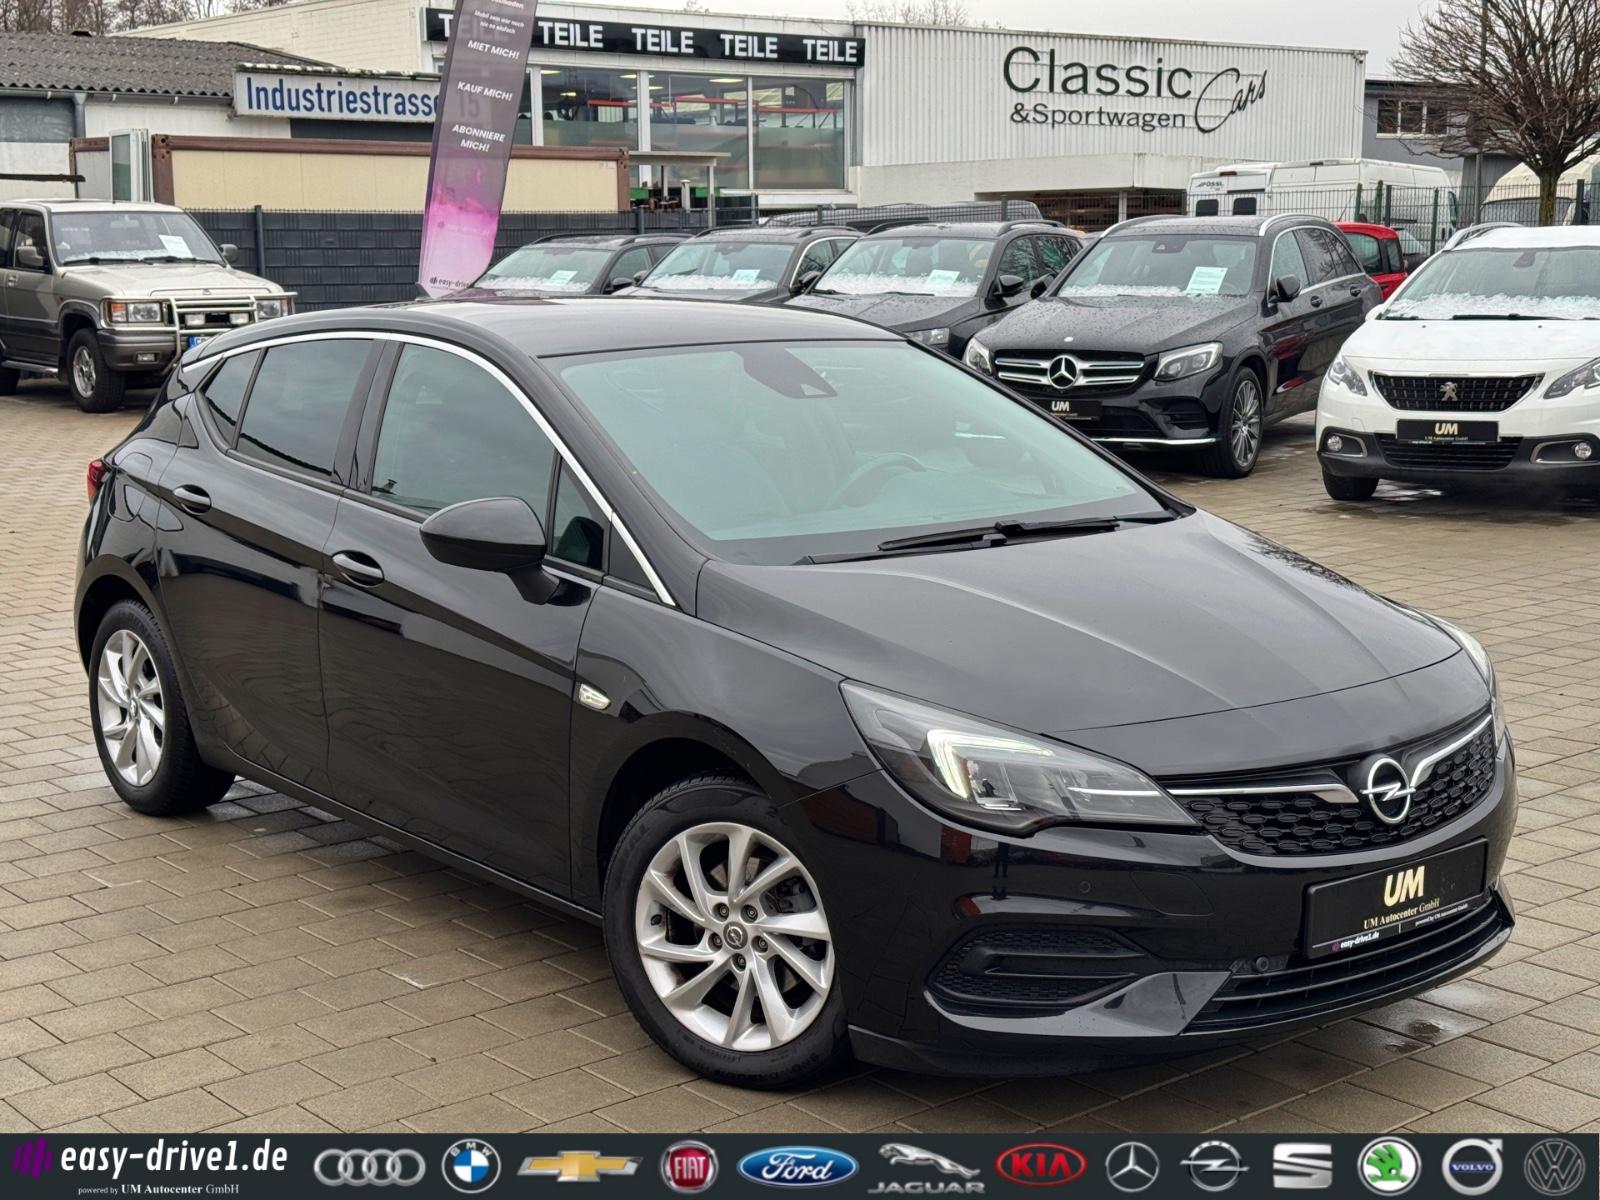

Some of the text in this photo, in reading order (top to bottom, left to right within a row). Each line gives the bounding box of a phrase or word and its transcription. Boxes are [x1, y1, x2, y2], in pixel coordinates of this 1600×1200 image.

[467, 40, 520, 60] MIET MICH!
[538, 20, 604, 48] TEILE
[631, 27, 694, 54] TEILE
[720, 33, 778, 59] TEILE
[802, 38, 858, 63] TEILE
[457, 81, 513, 101] KAUF MICH!
[1003, 46, 1267, 133] Classic Cars
[1010, 102, 1186, 132] &Sportwagen
[452, 124, 506, 143] ABONNIERE
[460, 138, 490, 153] MICH!
[1051, 401, 1070, 412] UM
[1434, 422, 1459, 435] UM
[1383, 865, 1426, 907] UM
[1363, 897, 1440, 930] UM Autocenter GmbH
[1340, 931, 1380, 949] easy-drive1.de
